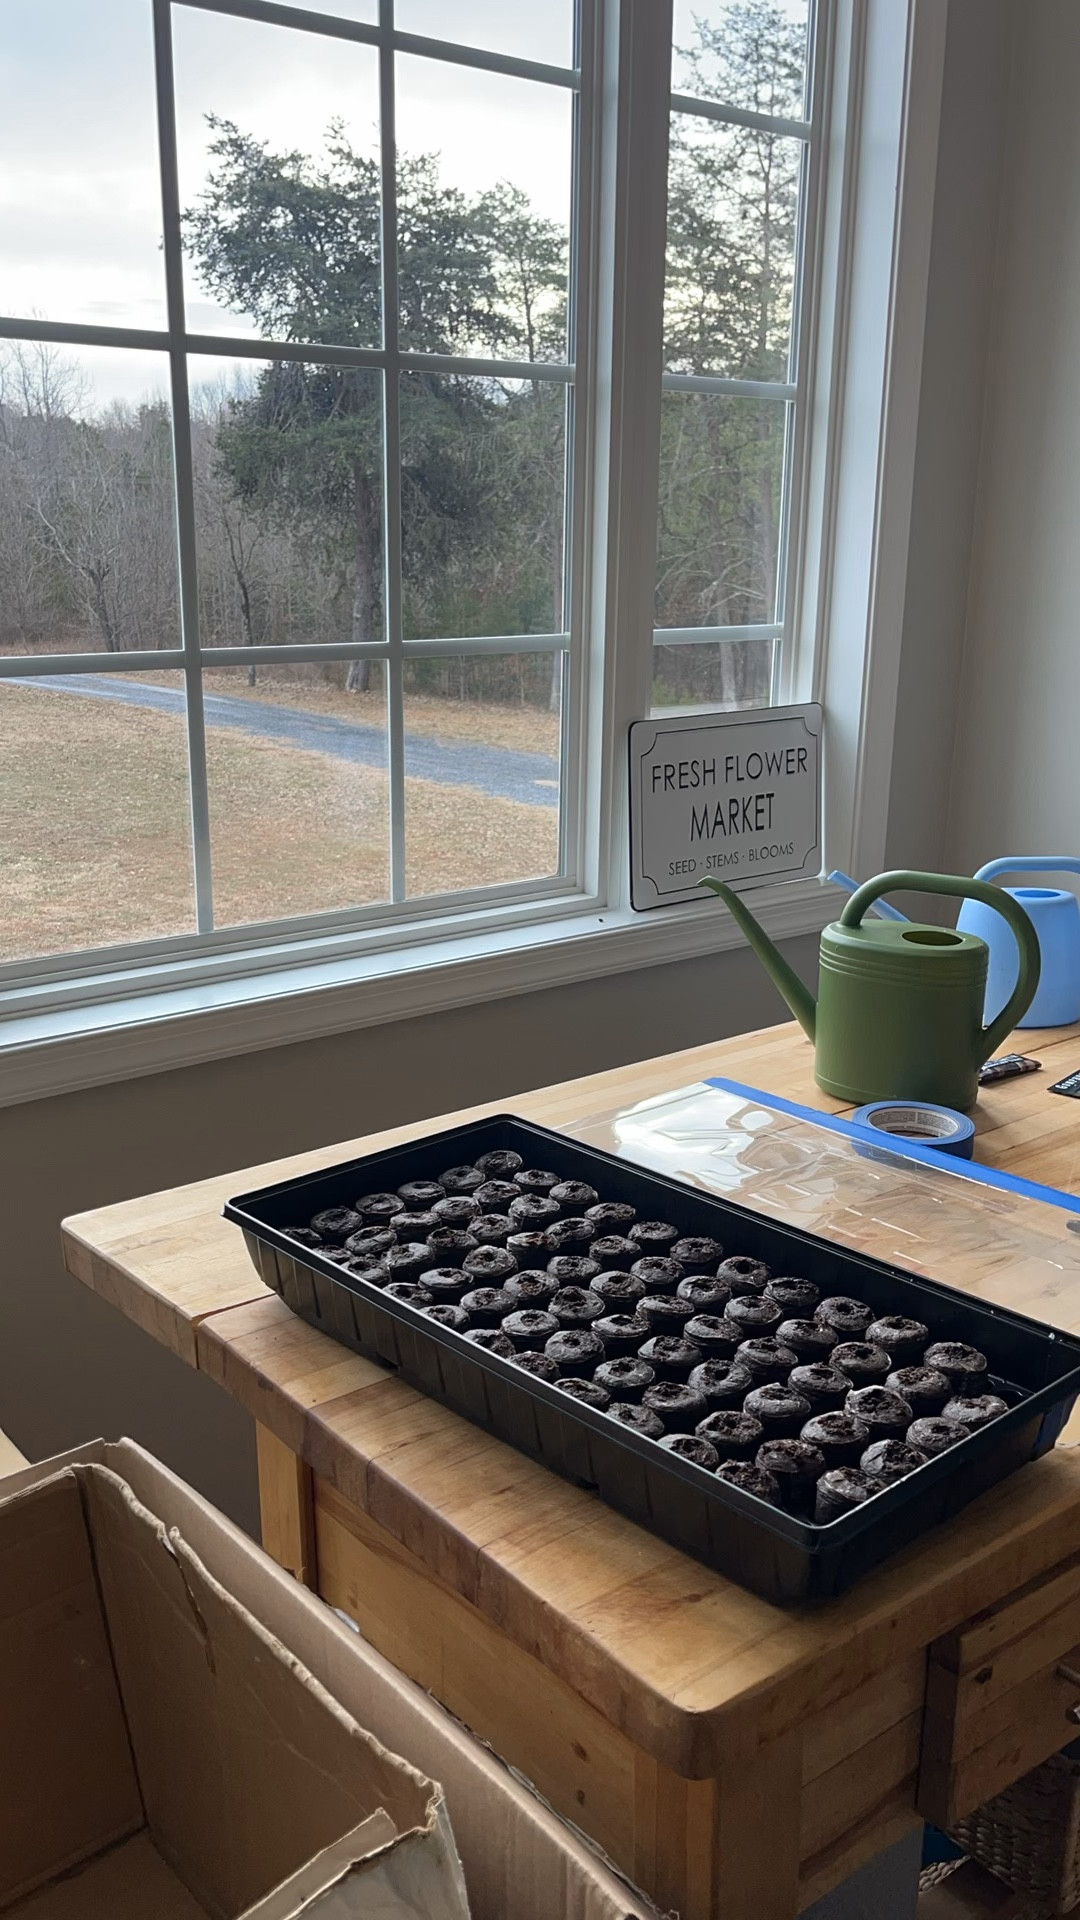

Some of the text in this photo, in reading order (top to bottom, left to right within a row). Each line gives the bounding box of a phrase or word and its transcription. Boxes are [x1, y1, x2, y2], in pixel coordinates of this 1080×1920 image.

[652, 747, 808, 793] FRESH FLOWER
[690, 792, 775, 841] MARKET
[668, 842, 794, 876] SEED STEMS BLOOMS
